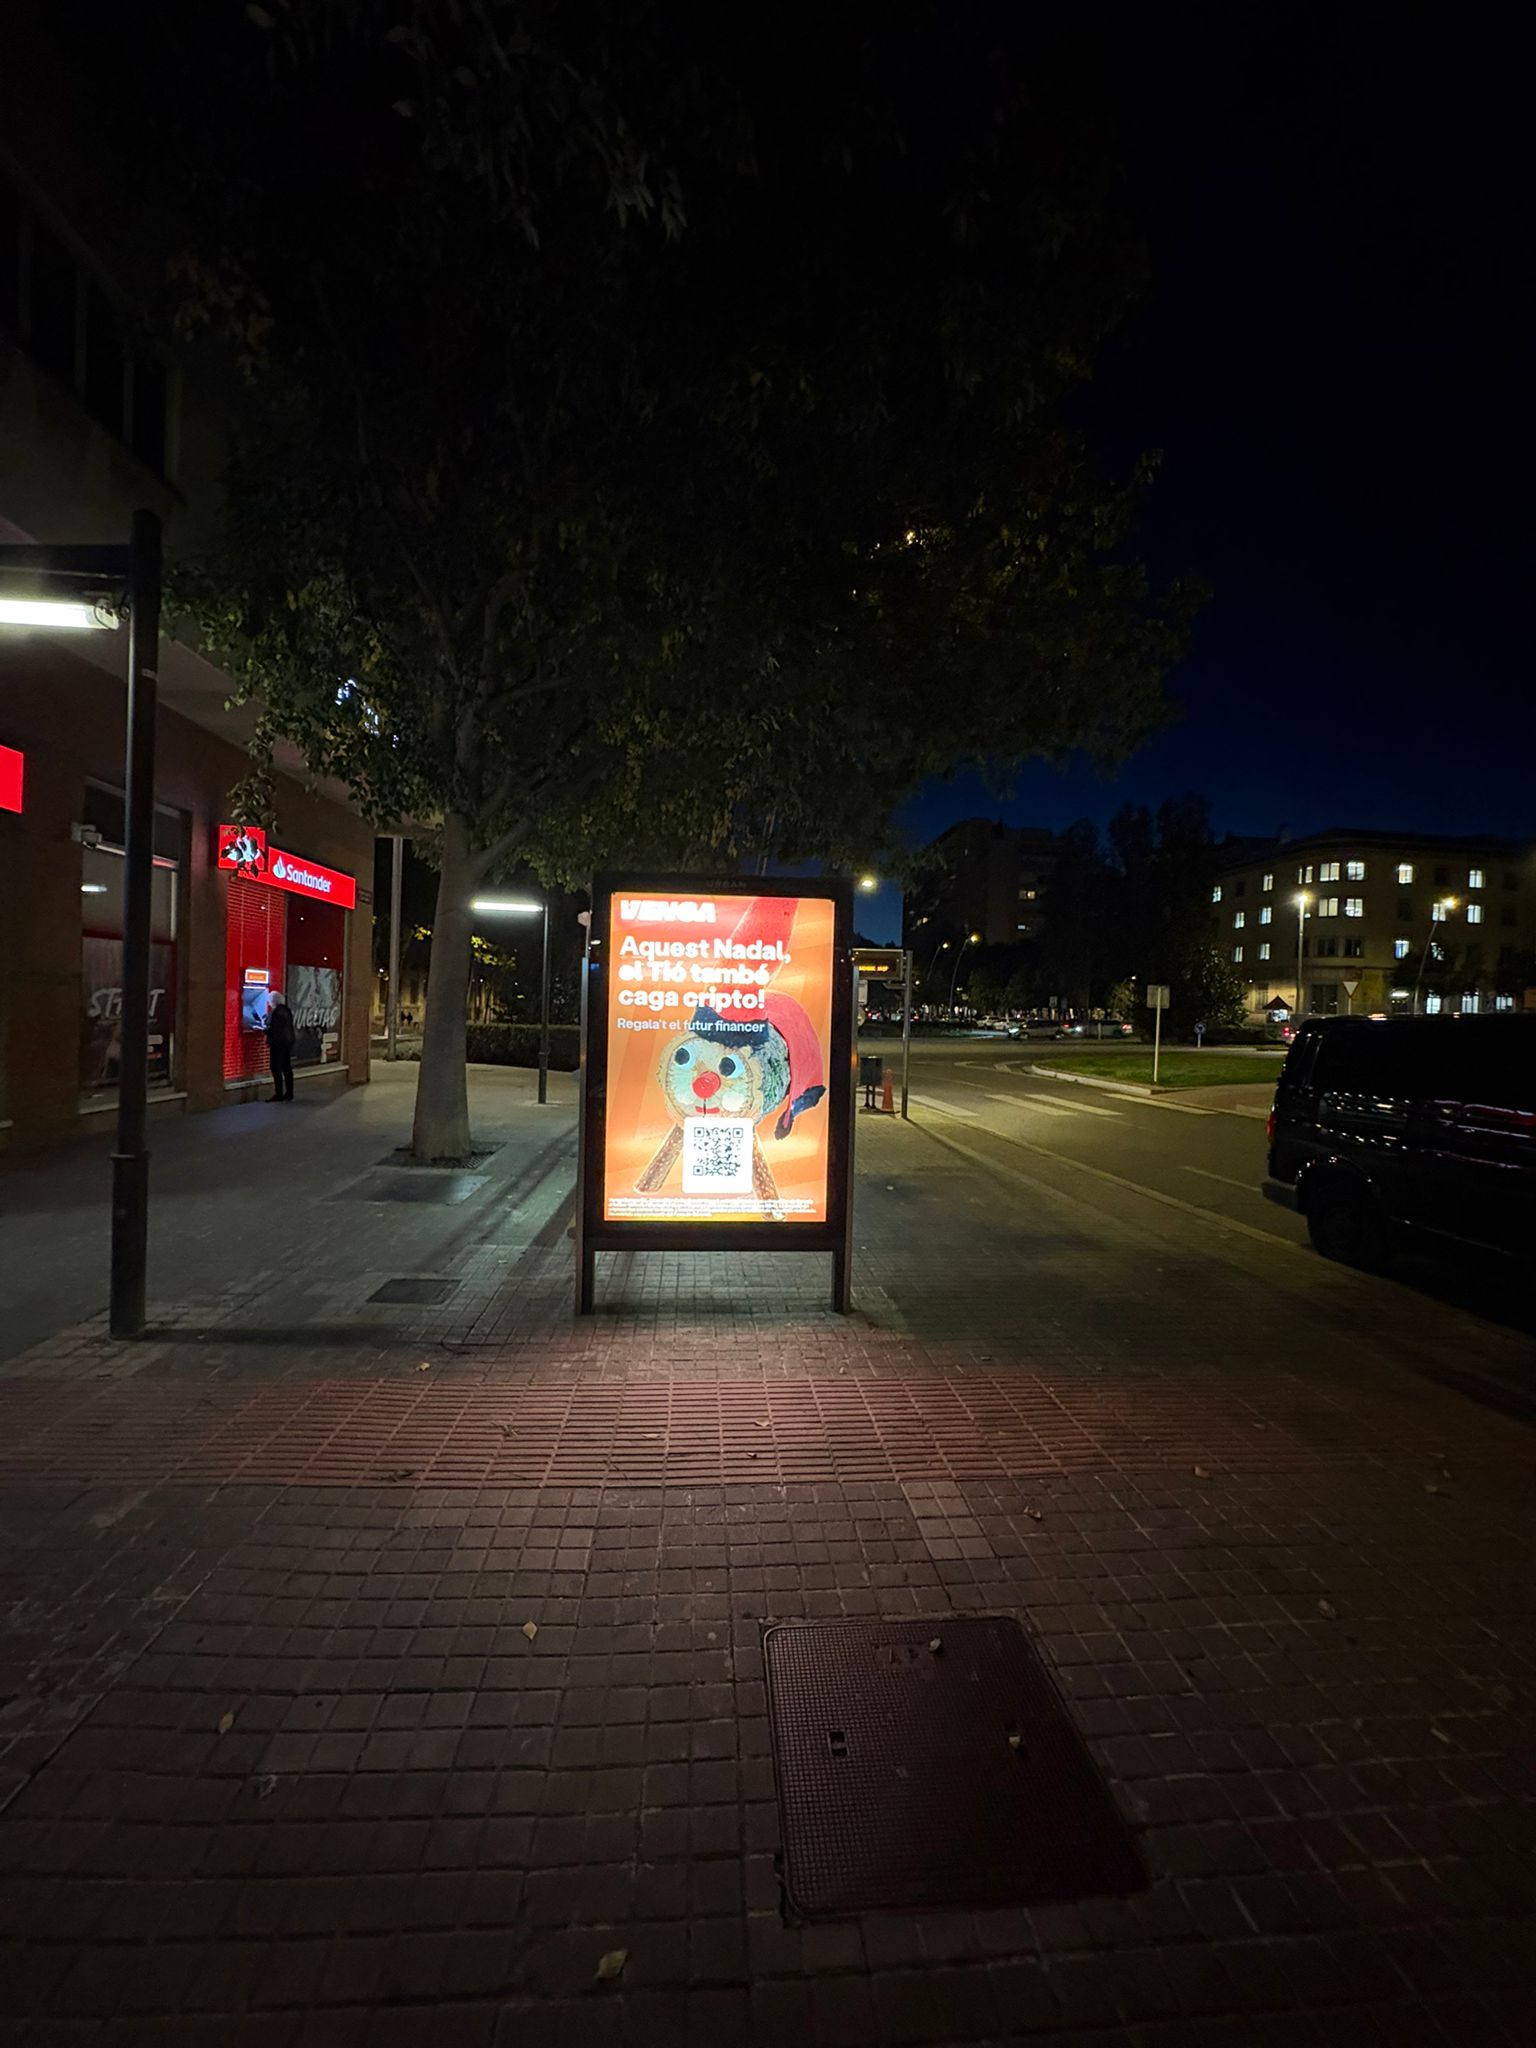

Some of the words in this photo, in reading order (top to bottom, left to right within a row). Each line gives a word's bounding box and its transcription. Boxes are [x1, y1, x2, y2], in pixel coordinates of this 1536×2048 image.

[286, 863, 332, 893] Santander
[620, 899, 717, 923] VENGA
[619, 936, 709, 961] Aquest
[714, 938, 791, 964] Nadal,
[618, 960, 644, 981] el
[647, 960, 687, 983] Tió
[690, 963, 770, 985] també
[618, 990, 679, 1012] caga
[683, 986, 765, 1012] cripto!
[617, 1018, 667, 1031] Regala't
[669, 1019, 681, 1030] el
[683, 1019, 713, 1031] futur
[715, 1019, 766, 1032] financer
